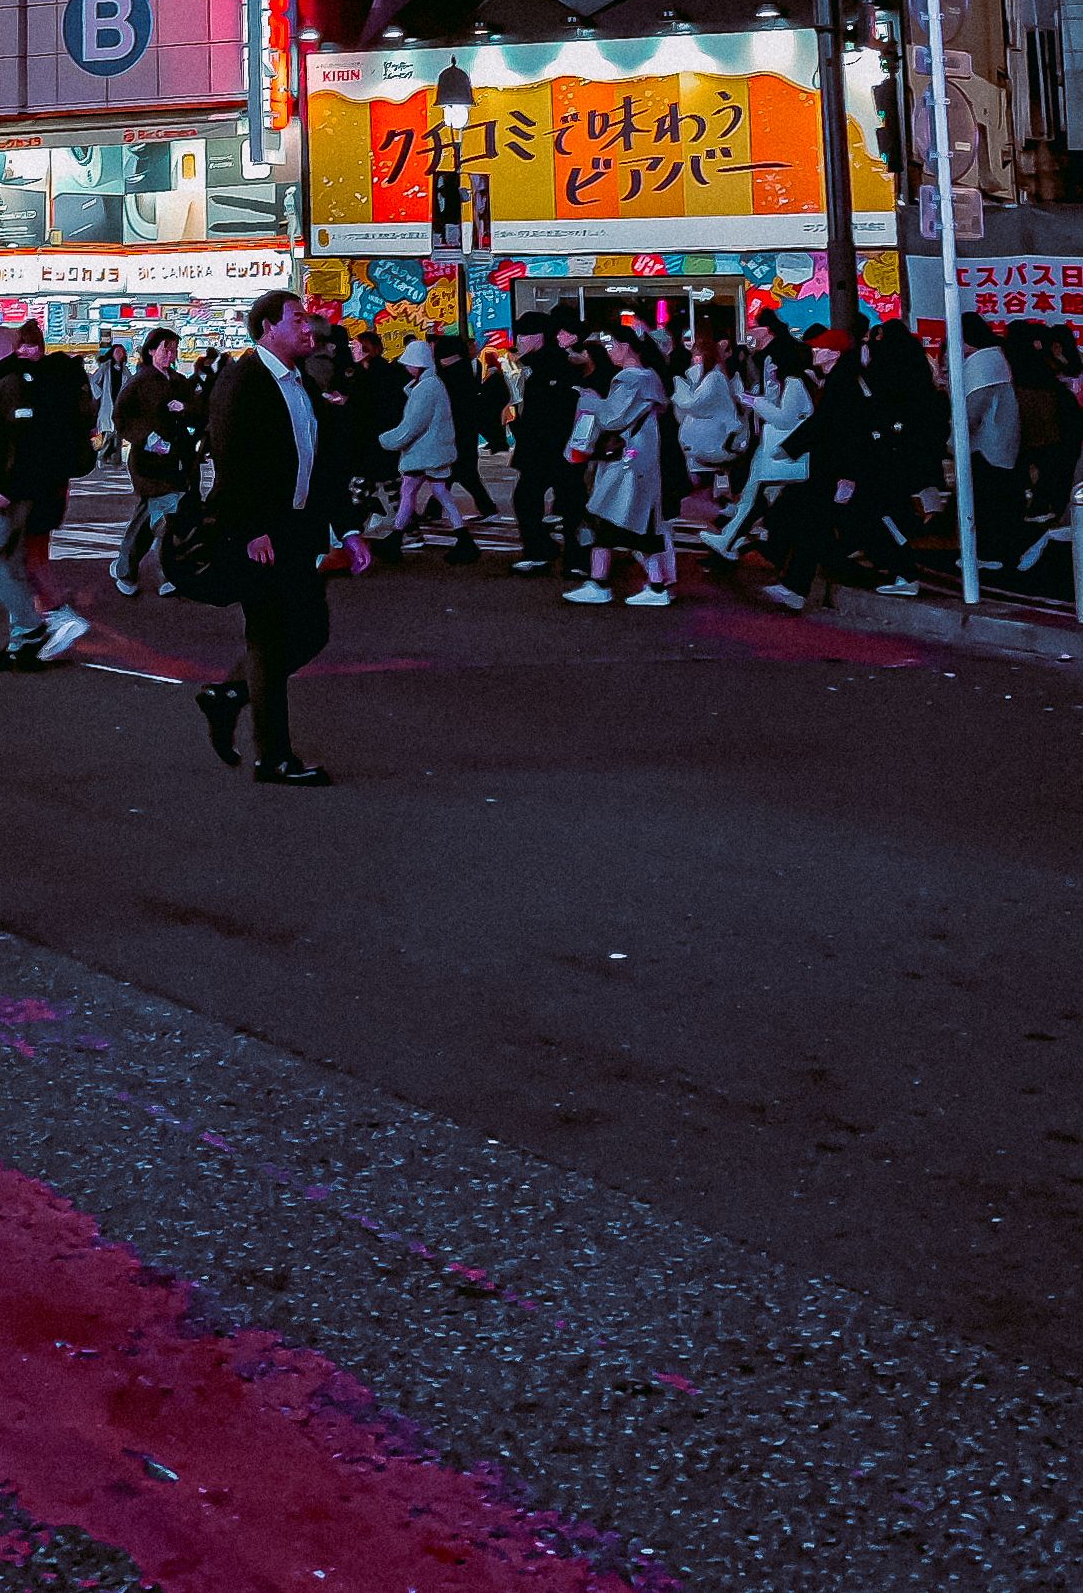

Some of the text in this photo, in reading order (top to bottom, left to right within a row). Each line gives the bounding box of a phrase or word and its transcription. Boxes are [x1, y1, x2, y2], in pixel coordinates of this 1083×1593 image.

[322, 69, 361, 82] KIRIN
[378, 90, 745, 185] クチコミで味わう
[565, 147, 794, 206] ビアバー
[225, 261, 288, 278] ビックカメ
[975, 291, 1083, 315] 渋谷本館
